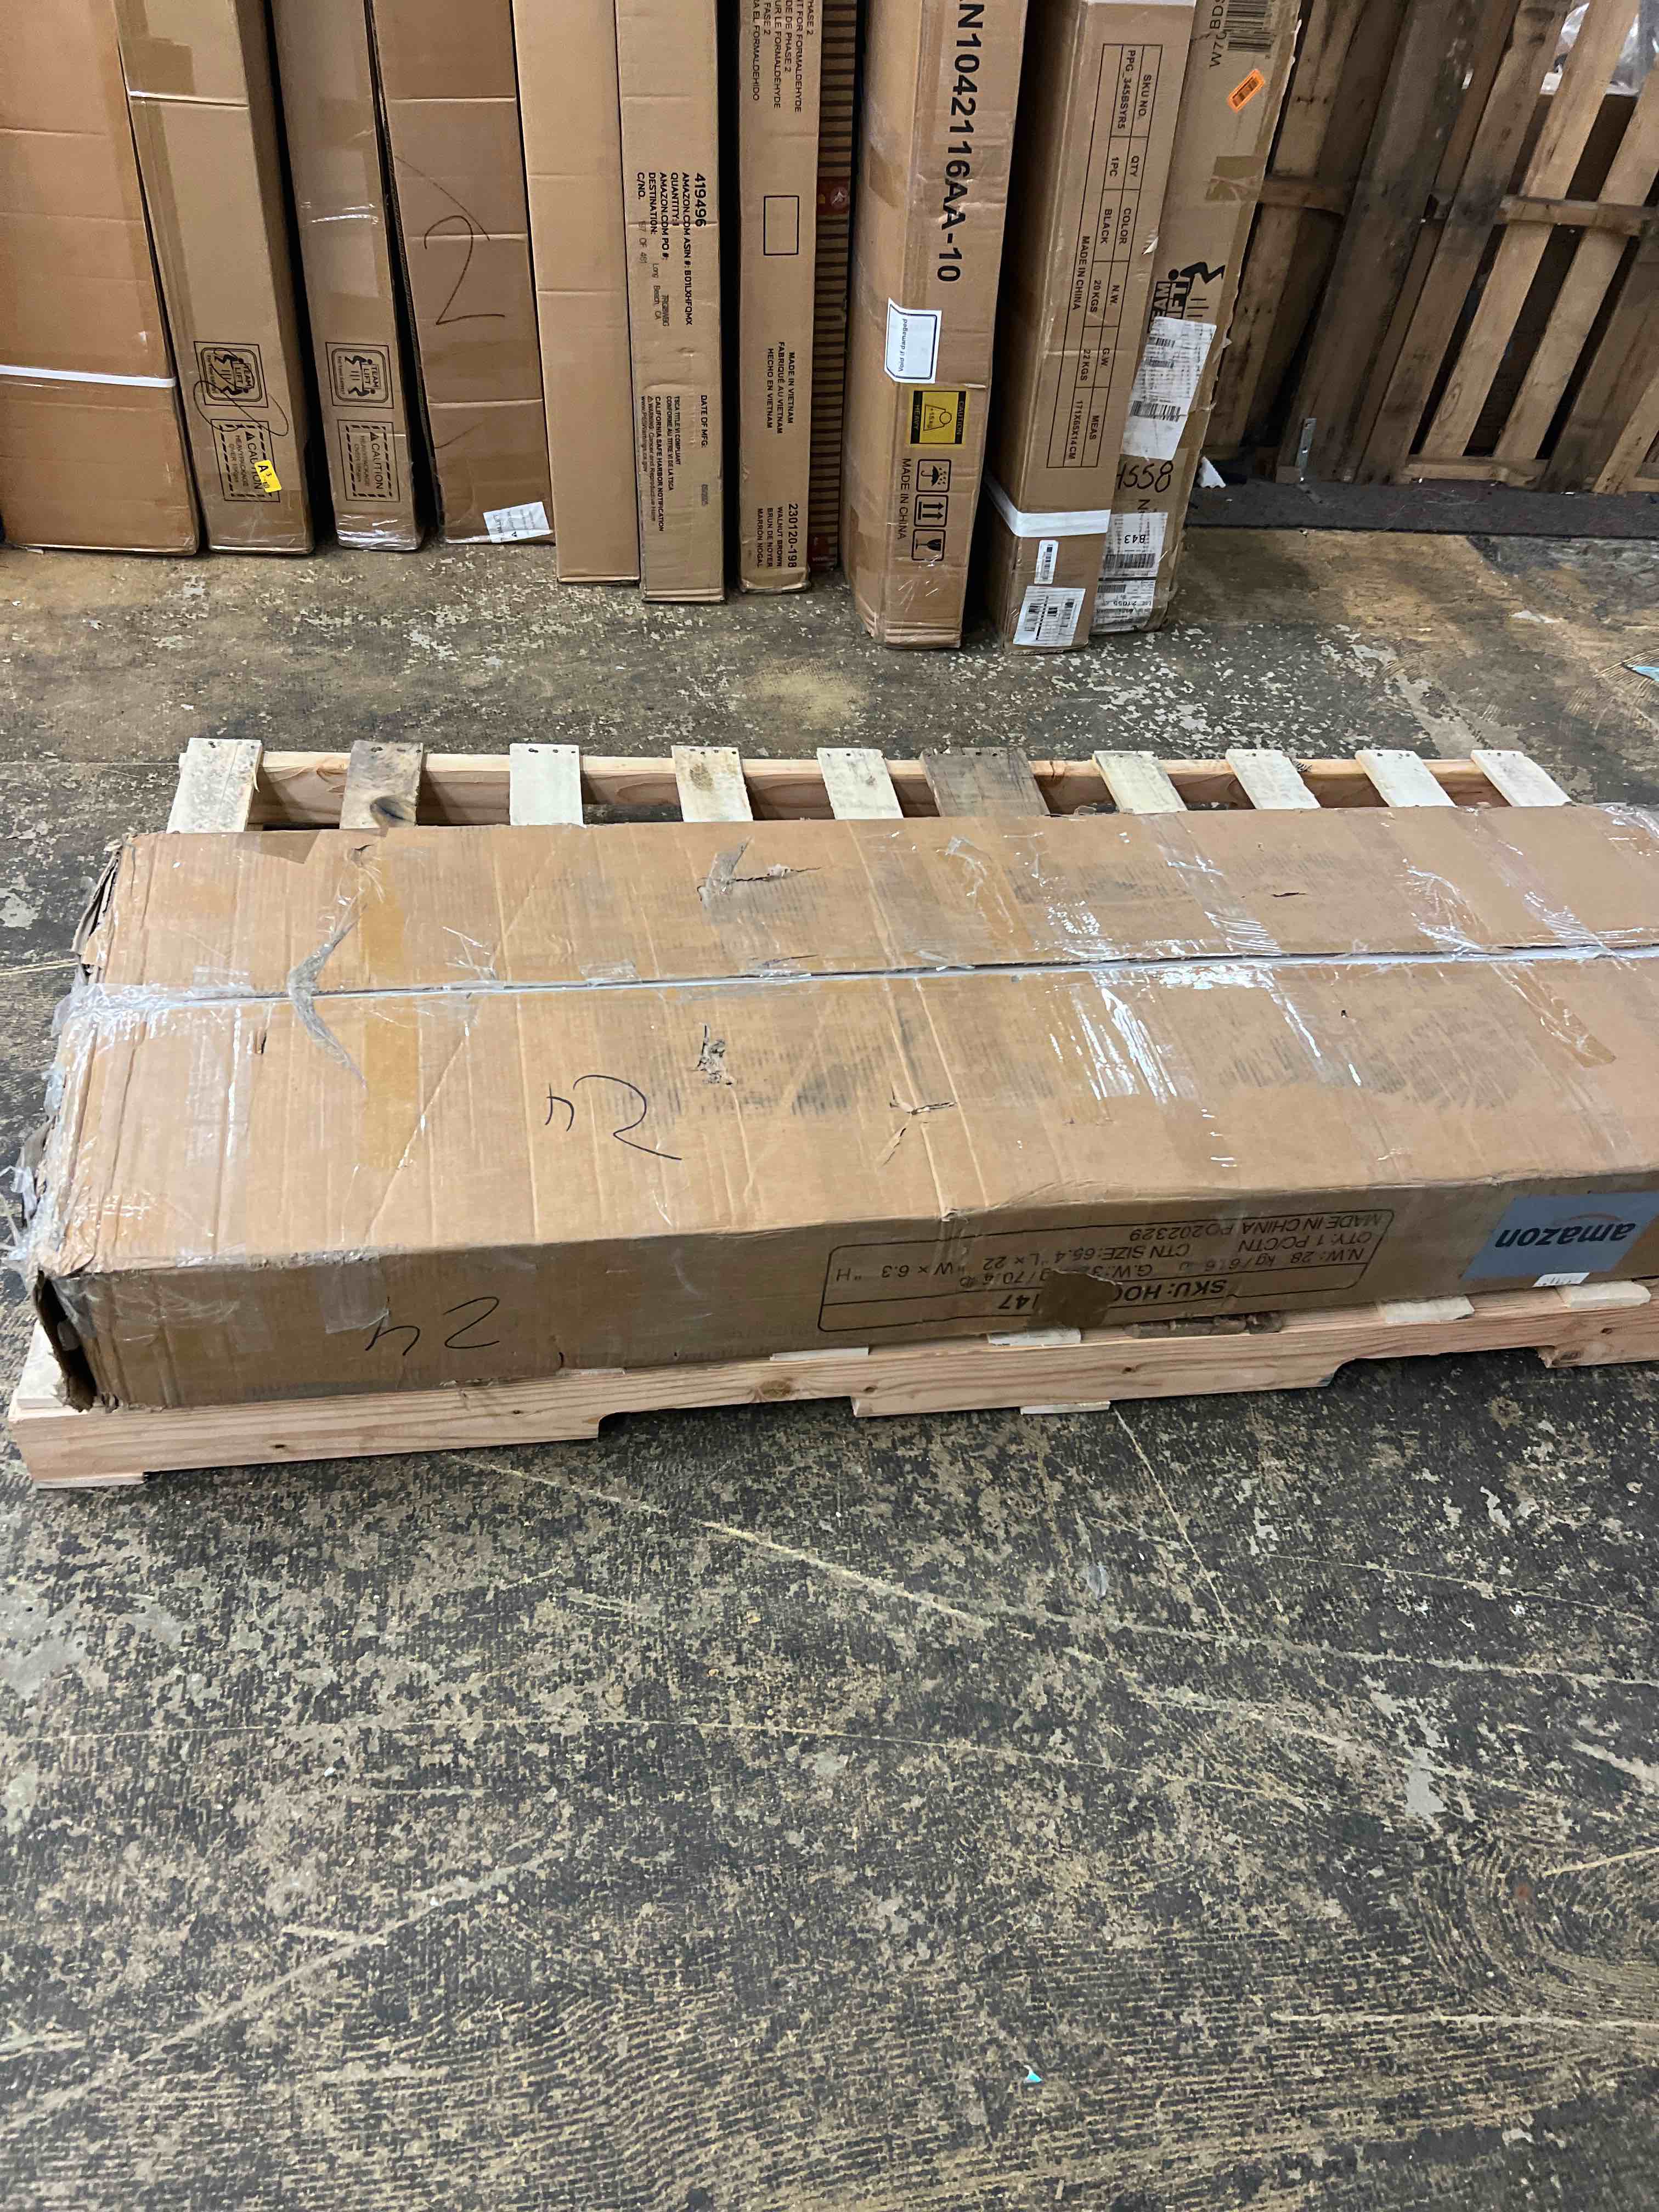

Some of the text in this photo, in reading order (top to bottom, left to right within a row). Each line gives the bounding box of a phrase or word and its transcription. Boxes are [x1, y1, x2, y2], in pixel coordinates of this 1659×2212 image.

[753, 12, 760, 22] EL
[775, 16, 781, 29] LE
[785, 16, 792, 29] DE
[795, 33, 803, 114] FORMALDEHYDE
[1141, 74, 1152, 97] SKU
[937, 0, 985, 283] N1042116AA-10
[1109, 157, 1119, 177] 1PC
[1129, 156, 1140, 177] QTY
[637, 172, 646, 200] C/NO.
[648, 172, 658, 235] DESTINATION:
[660, 172, 669, 235] AMAZON.COM
[682, 172, 691, 235] AMAZON.COM
[695, 172, 707, 227] 419496
[1101, 209, 1112, 244] BLACK
[1119, 208, 1131, 245] COLOR
[662, 238, 669, 250] PO
[424, 215, 506, 325] 2
[1073, 236, 1090, 310] MADE IN CHINA
[1090, 280, 1101, 313] 20 KGS
[1109, 285, 1120, 306] N.W.
[1100, 348, 1110, 368] G.W.
[235, 367, 243, 384] LIFT
[243, 365, 251, 388] TEAM
[371, 367, 379, 388] TEAM
[1080, 362, 1090, 381] KGS
[767, 380, 774, 391] EN
[777, 386, 783, 397] AU
[701, 417, 708, 427] OF
[1089, 415, 1099, 440] MEAS
[667, 428, 673, 437] AU
[371, 443, 383, 489] CAUTION
[897, 458, 911, 540] MADE IN CHINA
[767, 531, 773, 540] DE
[788, 504, 798, 568] 230120-198
[1242, 1218, 1300, 1234] CHINA
[1303, 1216, 1324, 1229] IN
[1325, 1215, 1382, 1229] MADE
[1237, 1235, 1309, 1252] PC/CTN
[1316, 1234, 1324, 1245] 1
[1496, 1222, 1636, 1248] amazon
[1149, 1243, 1190, 1259] CTN
[1290, 1251, 1315, 1263] 28
[882, 1265, 909, 1278] 6.3
[983, 1256, 1007, 1270] 22
[1167, 1279, 1227, 1298] SKU:
